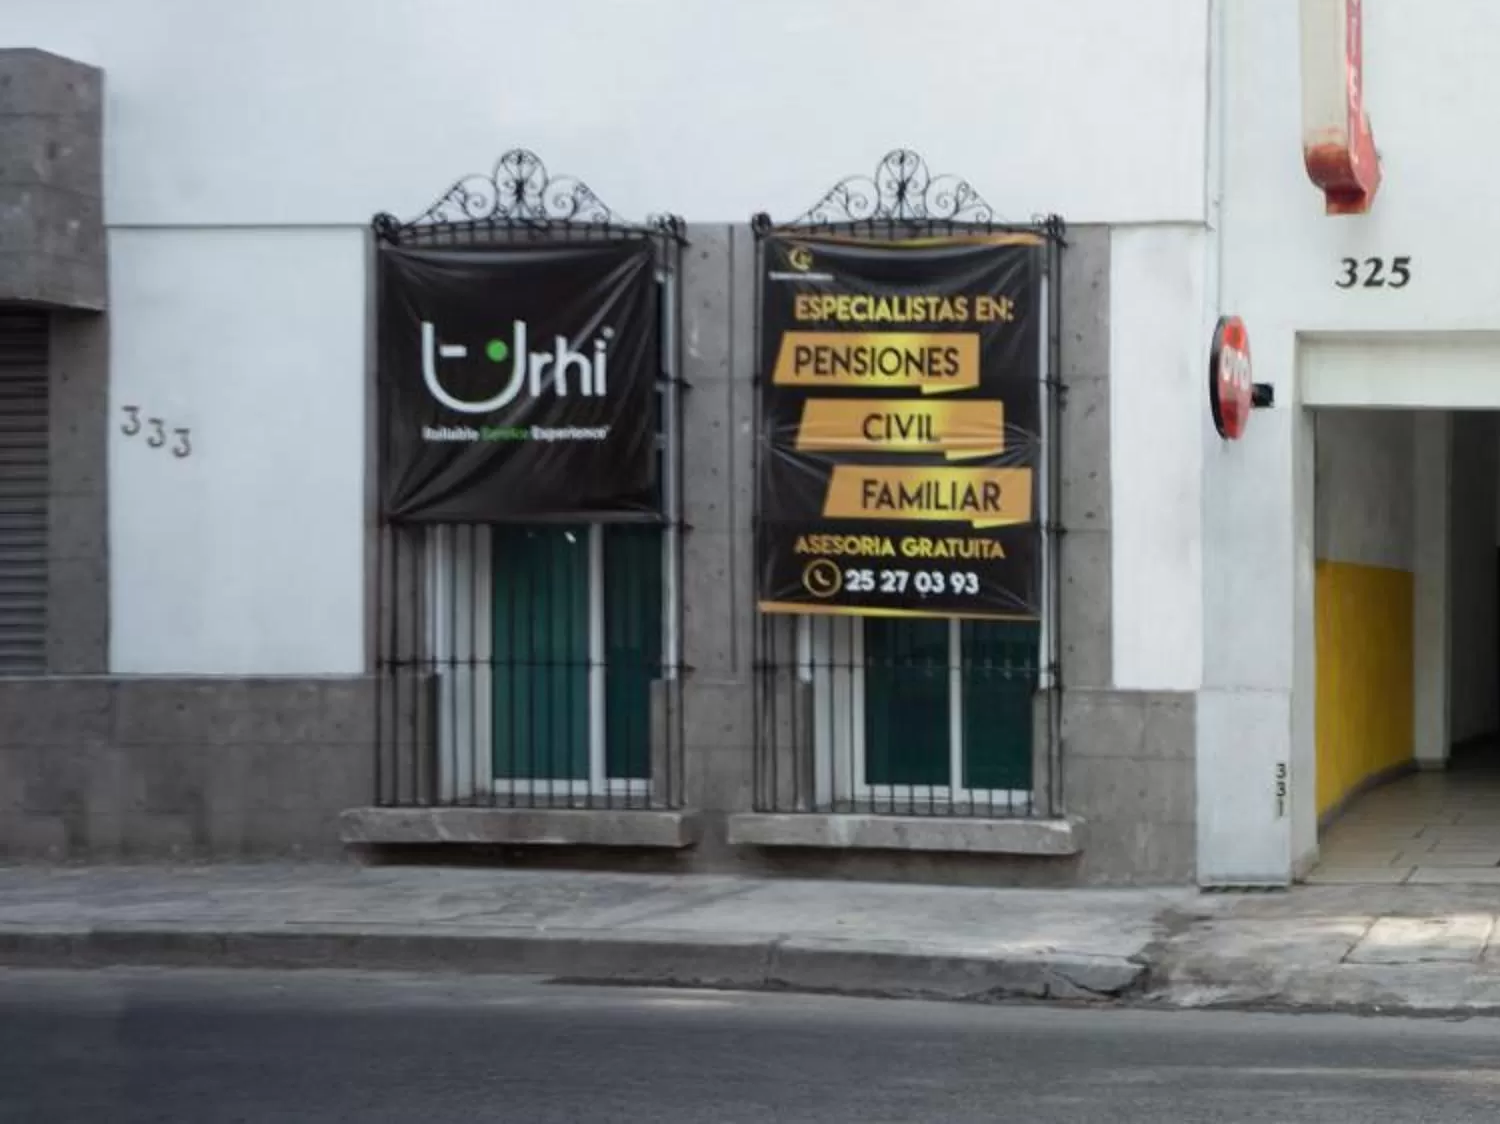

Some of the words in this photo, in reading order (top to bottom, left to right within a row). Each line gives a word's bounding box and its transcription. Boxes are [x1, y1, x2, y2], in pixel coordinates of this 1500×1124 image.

[1335, 256, 1411, 288] 325
[794, 295, 968, 322] ESPECIALISTAS
[974, 297, 1014, 321] EN:
[793, 346, 960, 377] PENSIONES
[120, 405, 192, 459] 333
[861, 414, 941, 442] CIVIL
[861, 480, 1003, 512] FAMILIAR
[795, 536, 895, 557] ASESORIA
[900, 538, 1006, 559] GRATUITA
[845, 569, 876, 592] 25
[880, 569, 908, 593] 27
[914, 571, 946, 594] 03
[949, 571, 980, 594] 93
[1275, 762, 1286, 818] 331
